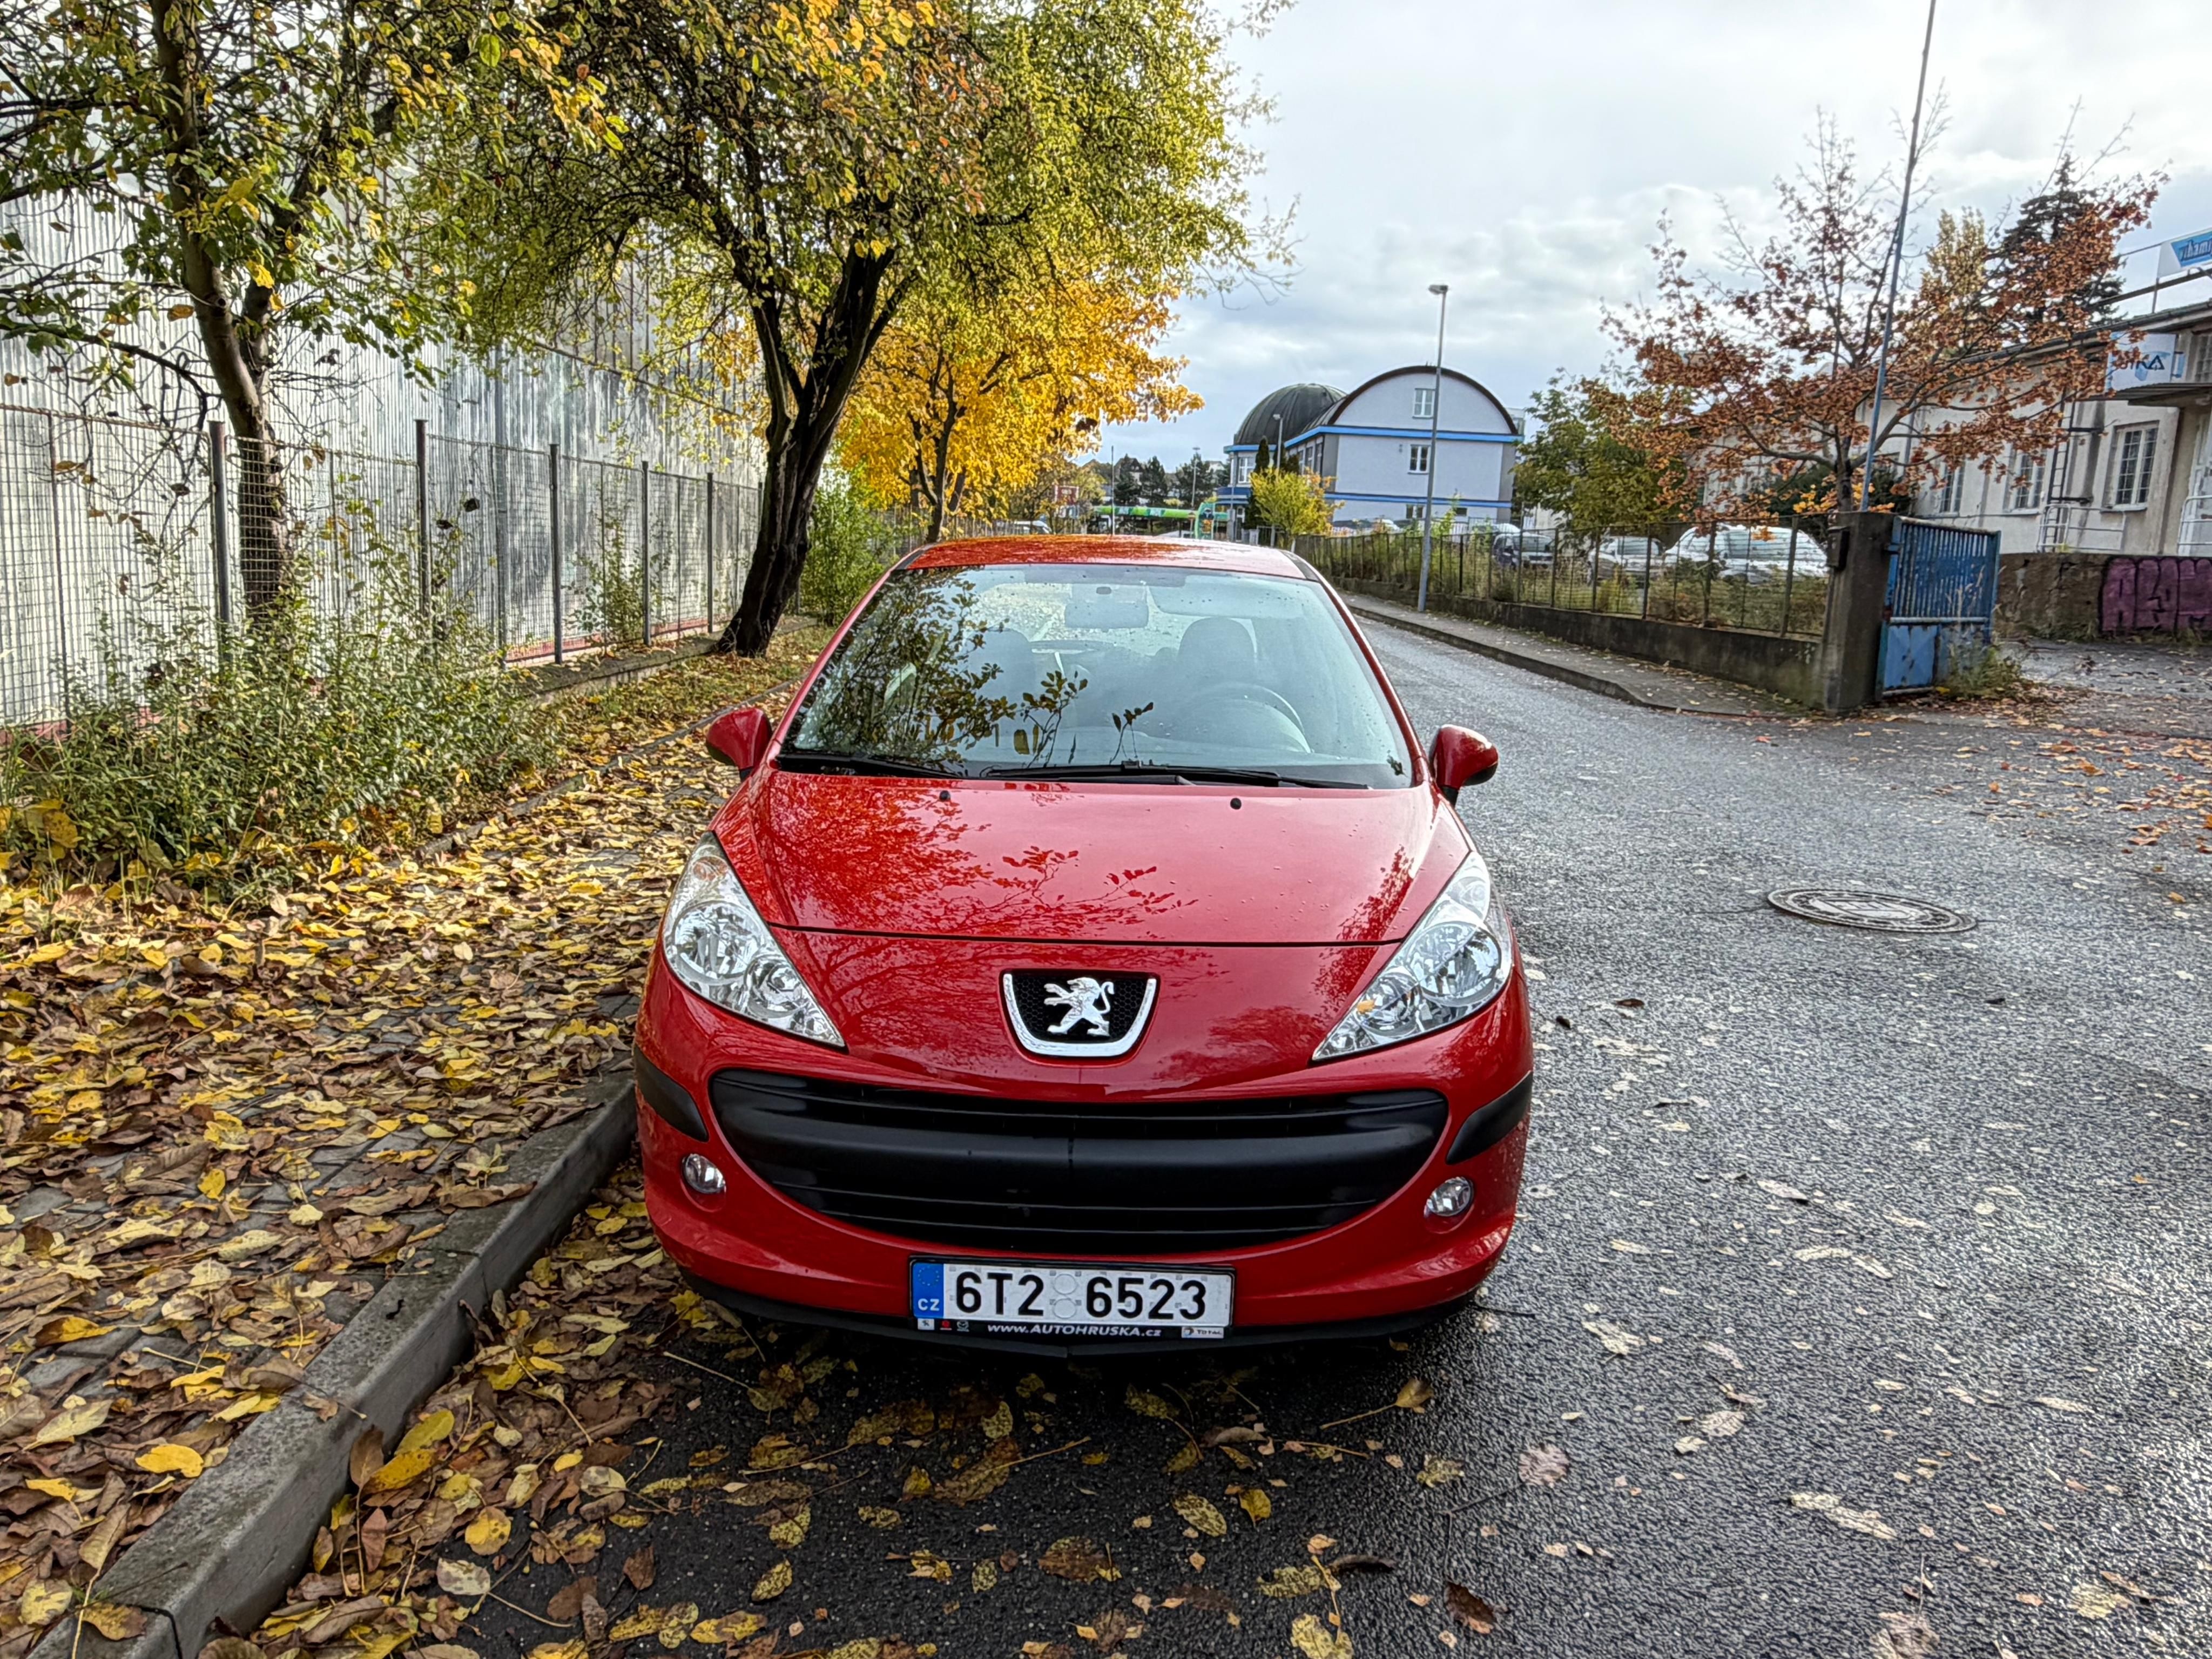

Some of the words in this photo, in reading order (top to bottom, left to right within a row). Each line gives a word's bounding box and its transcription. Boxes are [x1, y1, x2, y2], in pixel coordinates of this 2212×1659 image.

[956, 1271, 1044, 1316] 6T2
[1085, 1275, 1206, 1320] 6523
[918, 1298, 940, 1311] CZ
[987, 1323, 1162, 1337] www.AUTOHRUSKA.cz
